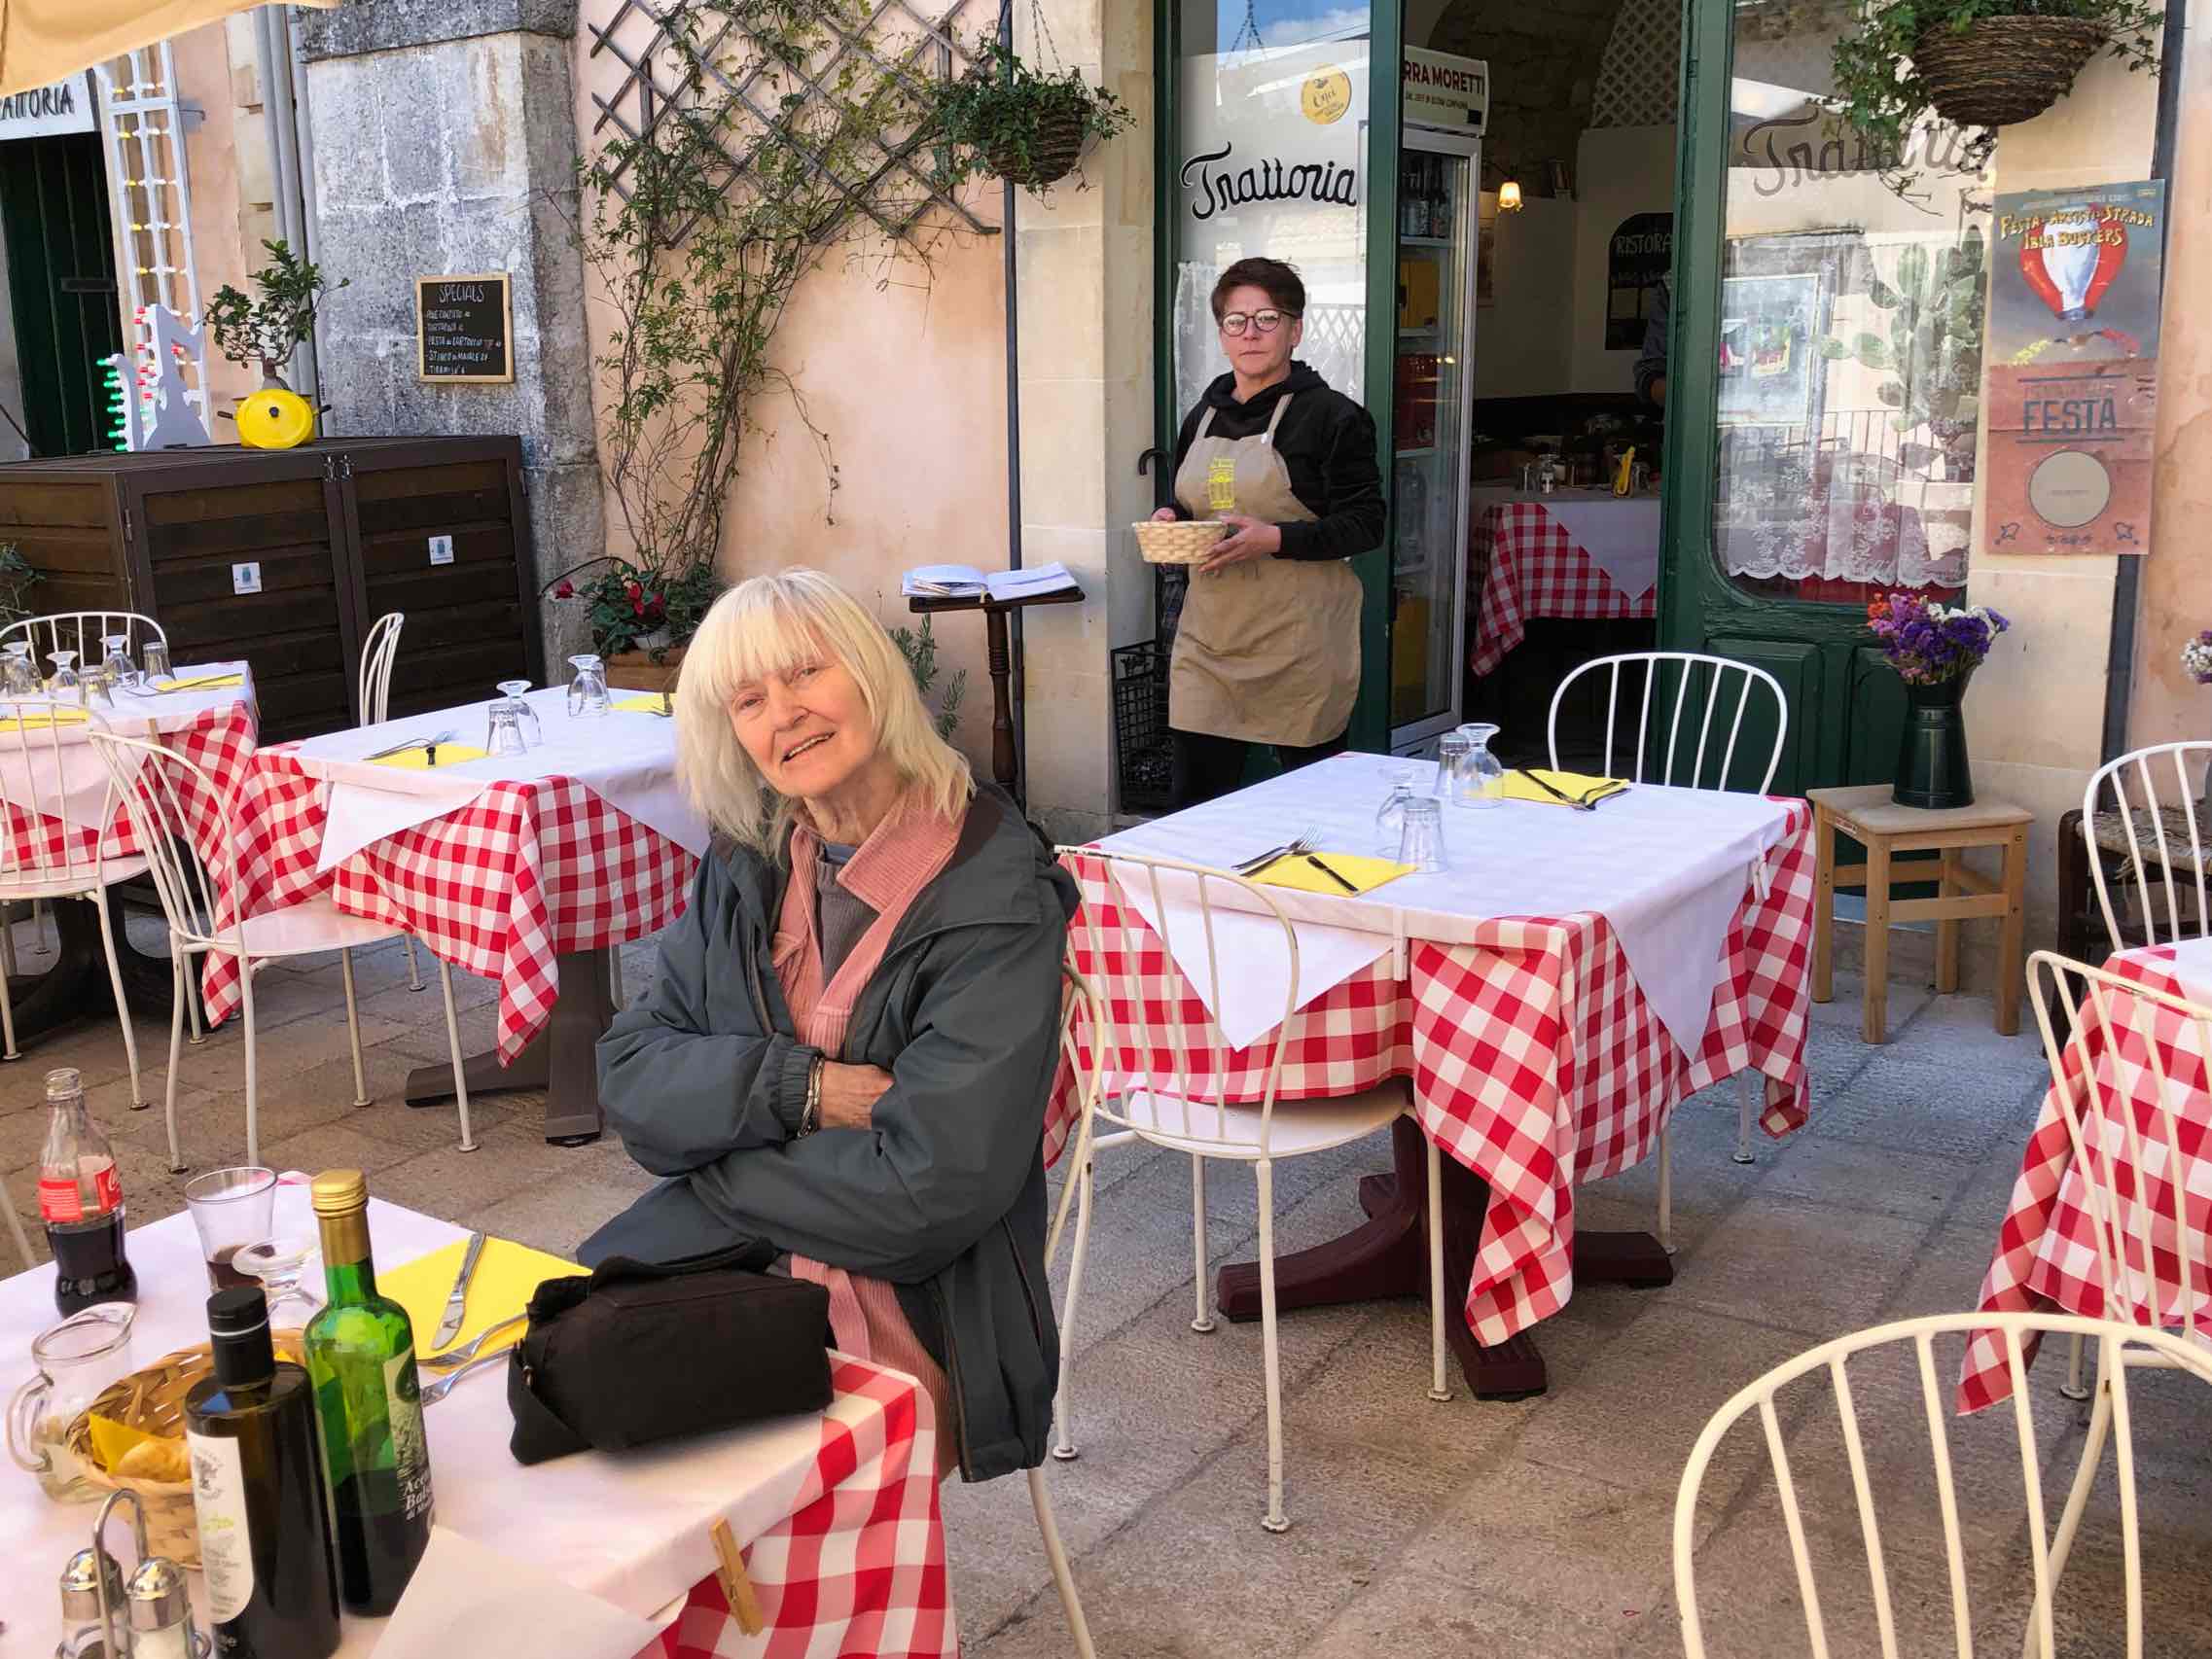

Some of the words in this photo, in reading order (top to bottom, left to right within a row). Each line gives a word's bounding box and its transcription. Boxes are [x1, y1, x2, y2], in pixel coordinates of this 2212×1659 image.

[1432, 65, 1486, 96] MORETTI
[0, 84, 76, 121] ATTORIA
[1180, 140, 1358, 220] Trattoria
[438, 283, 484, 303] SPECIALS
[2022, 397, 2118, 436] FESTA
